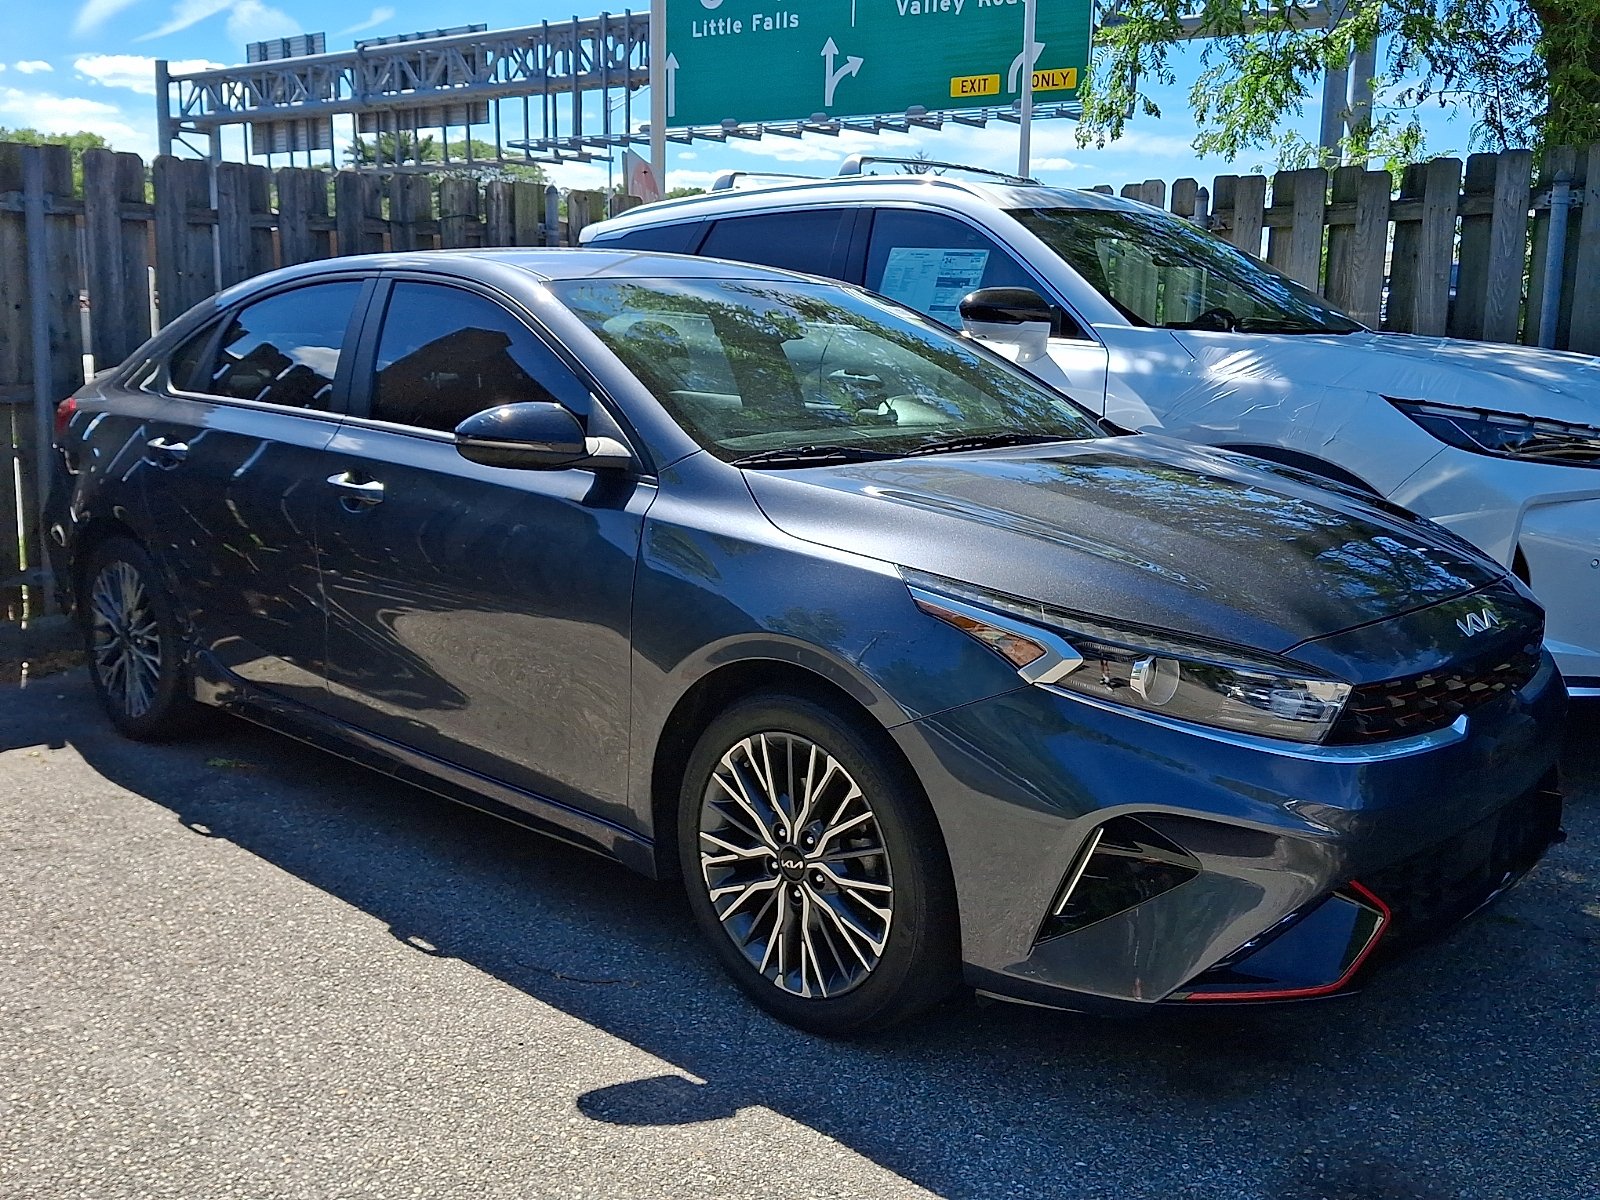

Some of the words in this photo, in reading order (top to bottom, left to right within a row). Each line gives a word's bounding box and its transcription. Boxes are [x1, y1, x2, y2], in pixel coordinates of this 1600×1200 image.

[896, 0, 965, 16] Valley
[692, 17, 742, 38] Little
[752, 10, 799, 32] Falls
[961, 78, 989, 94] EXIT
[1032, 71, 1070, 88] ONLY
[1455, 608, 1500, 637] KIA
[780, 859, 804, 869] KIA
